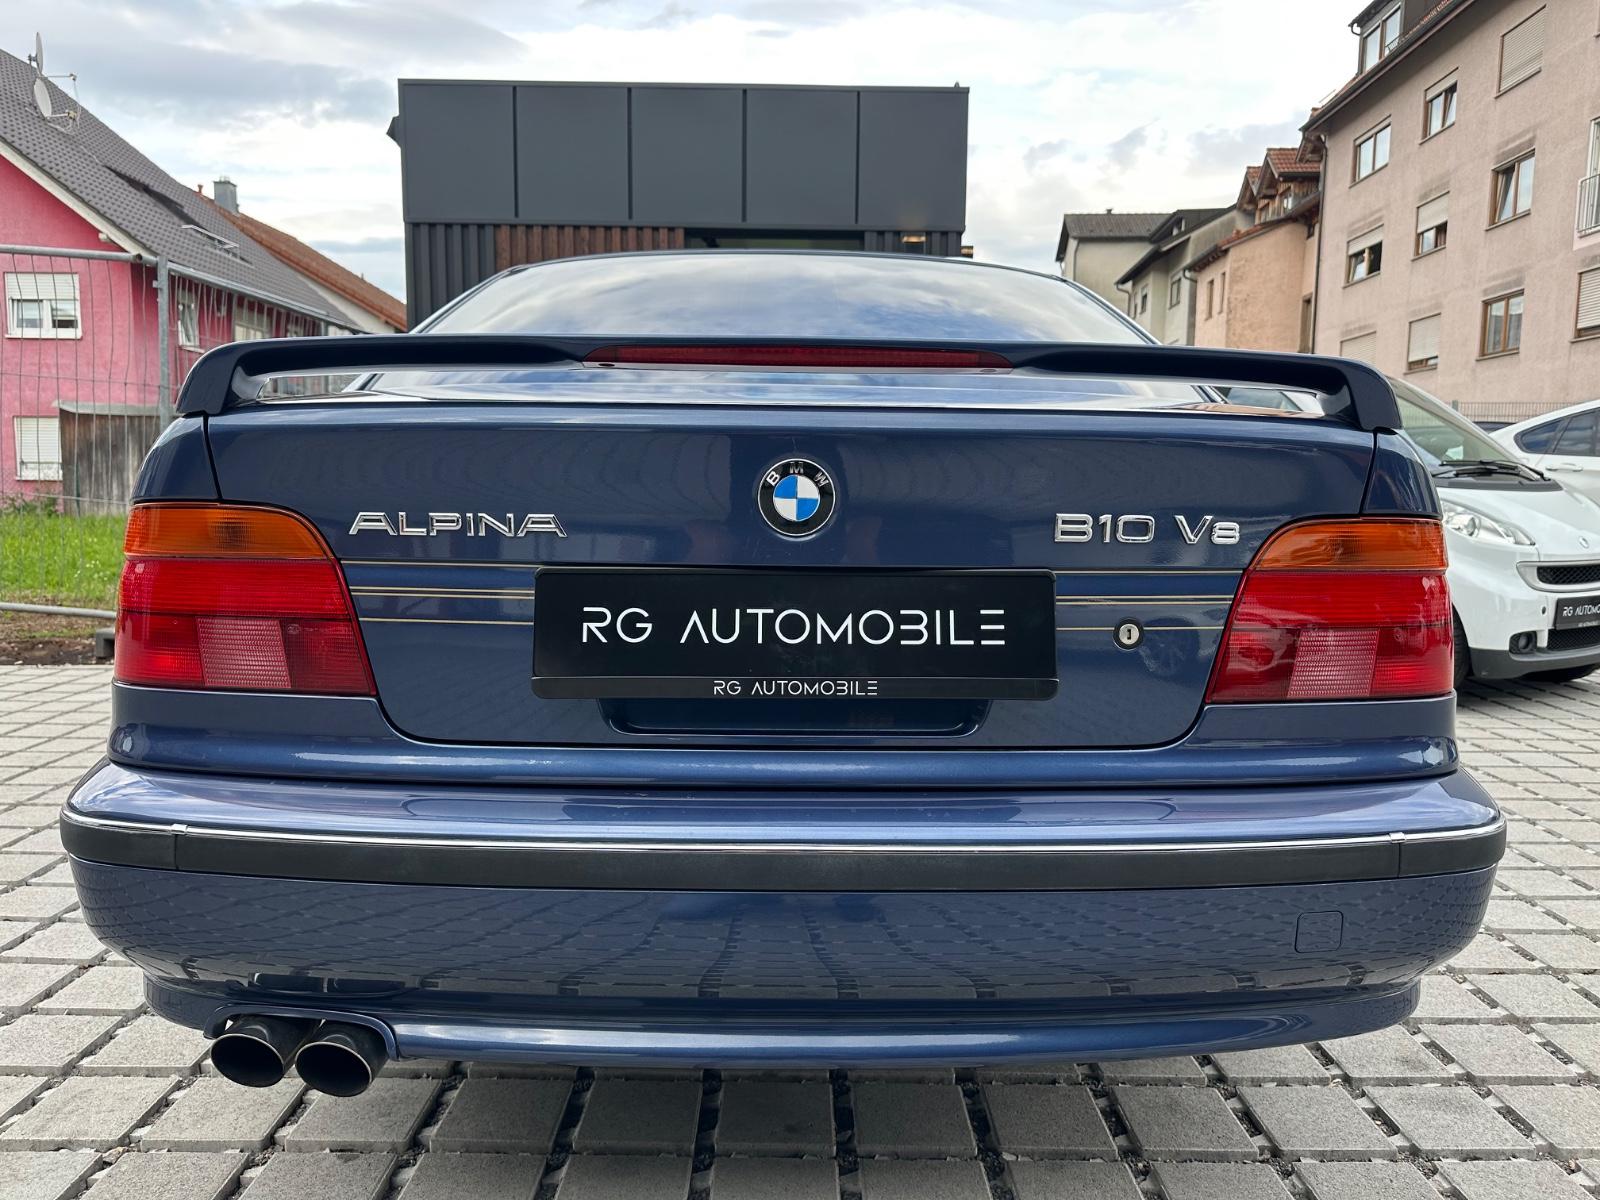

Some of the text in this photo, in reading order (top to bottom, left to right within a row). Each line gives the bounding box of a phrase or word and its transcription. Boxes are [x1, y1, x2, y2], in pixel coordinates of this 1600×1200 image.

[766, 461, 829, 487] BMW
[348, 511, 567, 538] ALPINA
[1053, 512, 1241, 545] B10 V8
[1562, 606, 1574, 617] RG
[582, 606, 1006, 645] RG AUTOMOBILE
[713, 680, 878, 696] RG AUTOMOBILE
